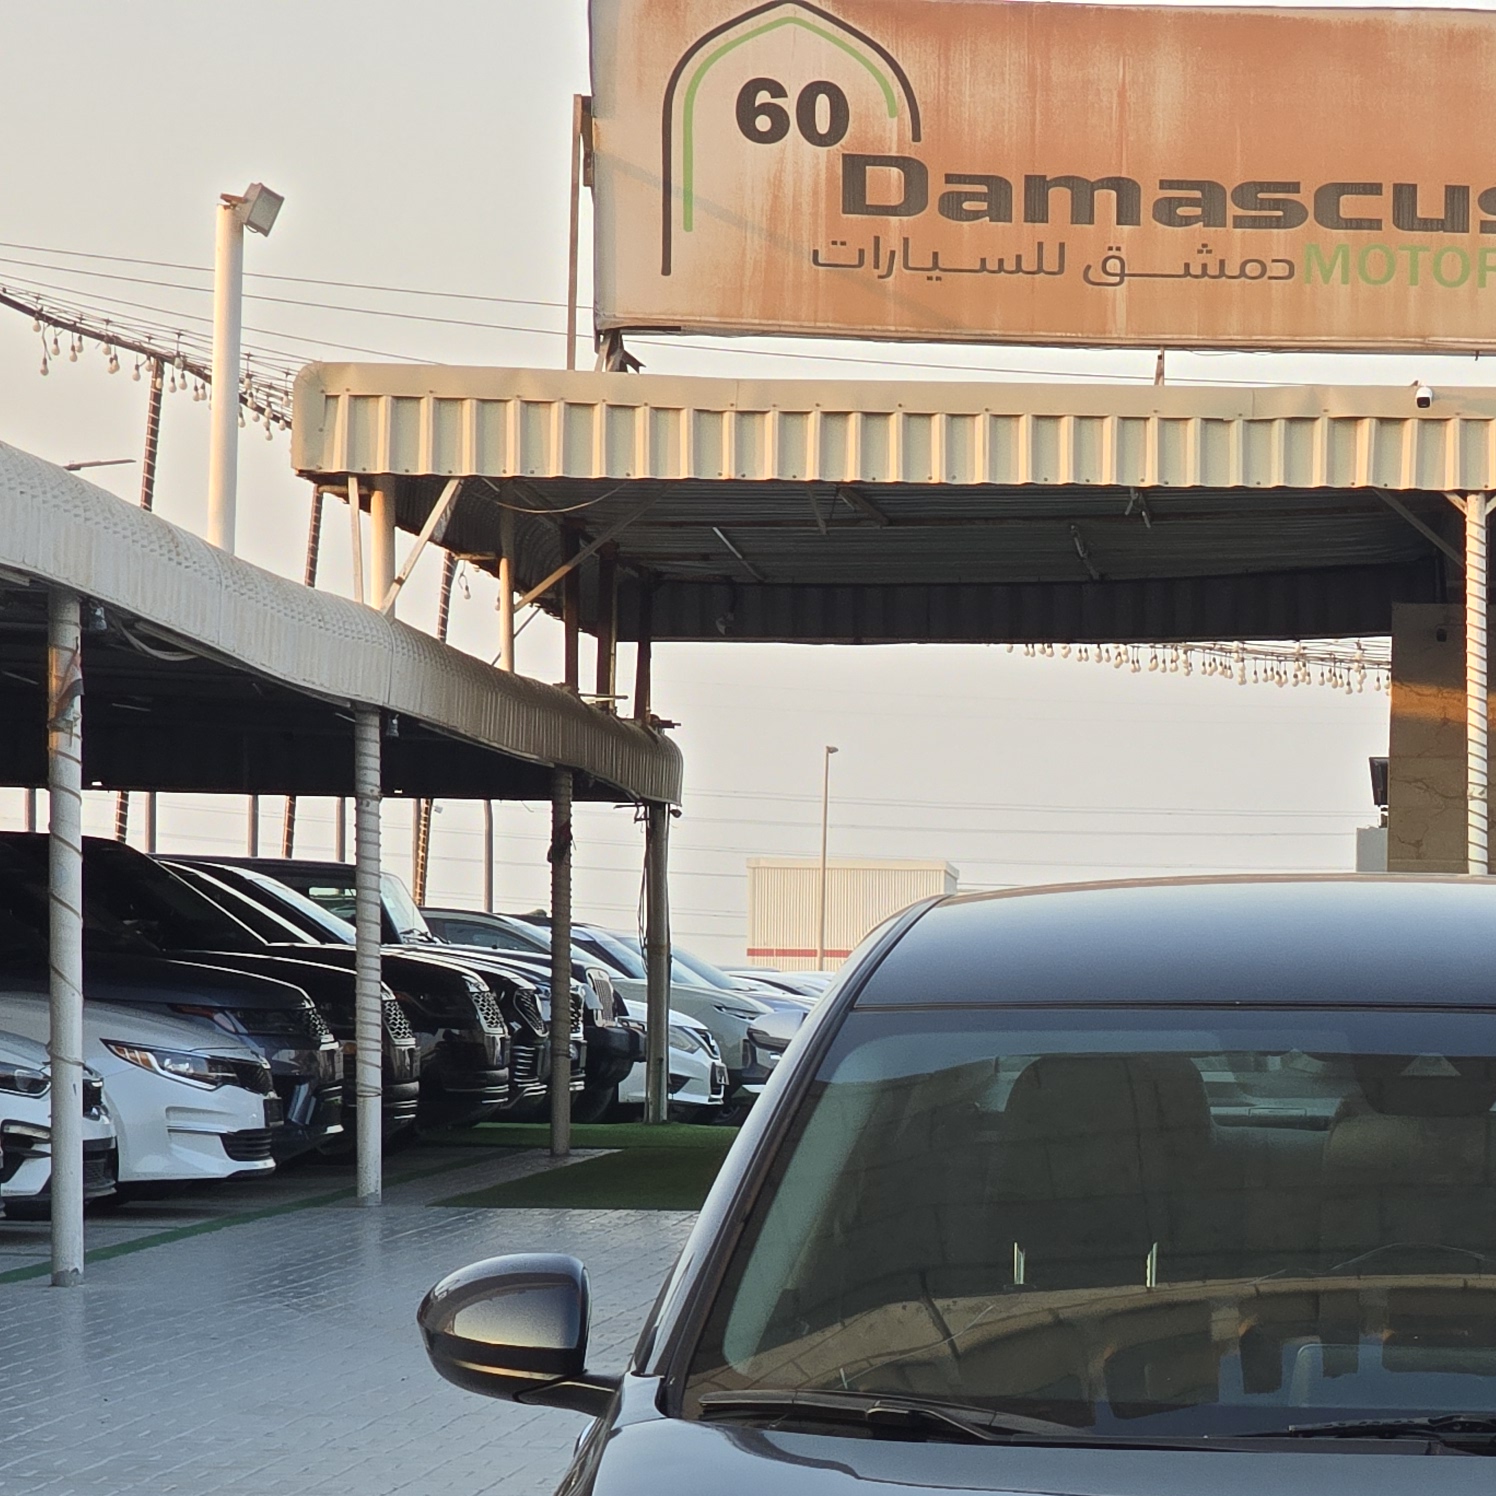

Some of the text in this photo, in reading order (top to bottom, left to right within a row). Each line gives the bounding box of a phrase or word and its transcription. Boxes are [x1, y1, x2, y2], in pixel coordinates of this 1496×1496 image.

[735, 78, 850, 147] 60
[811, 235, 1295, 287] دمشق للسيارات
